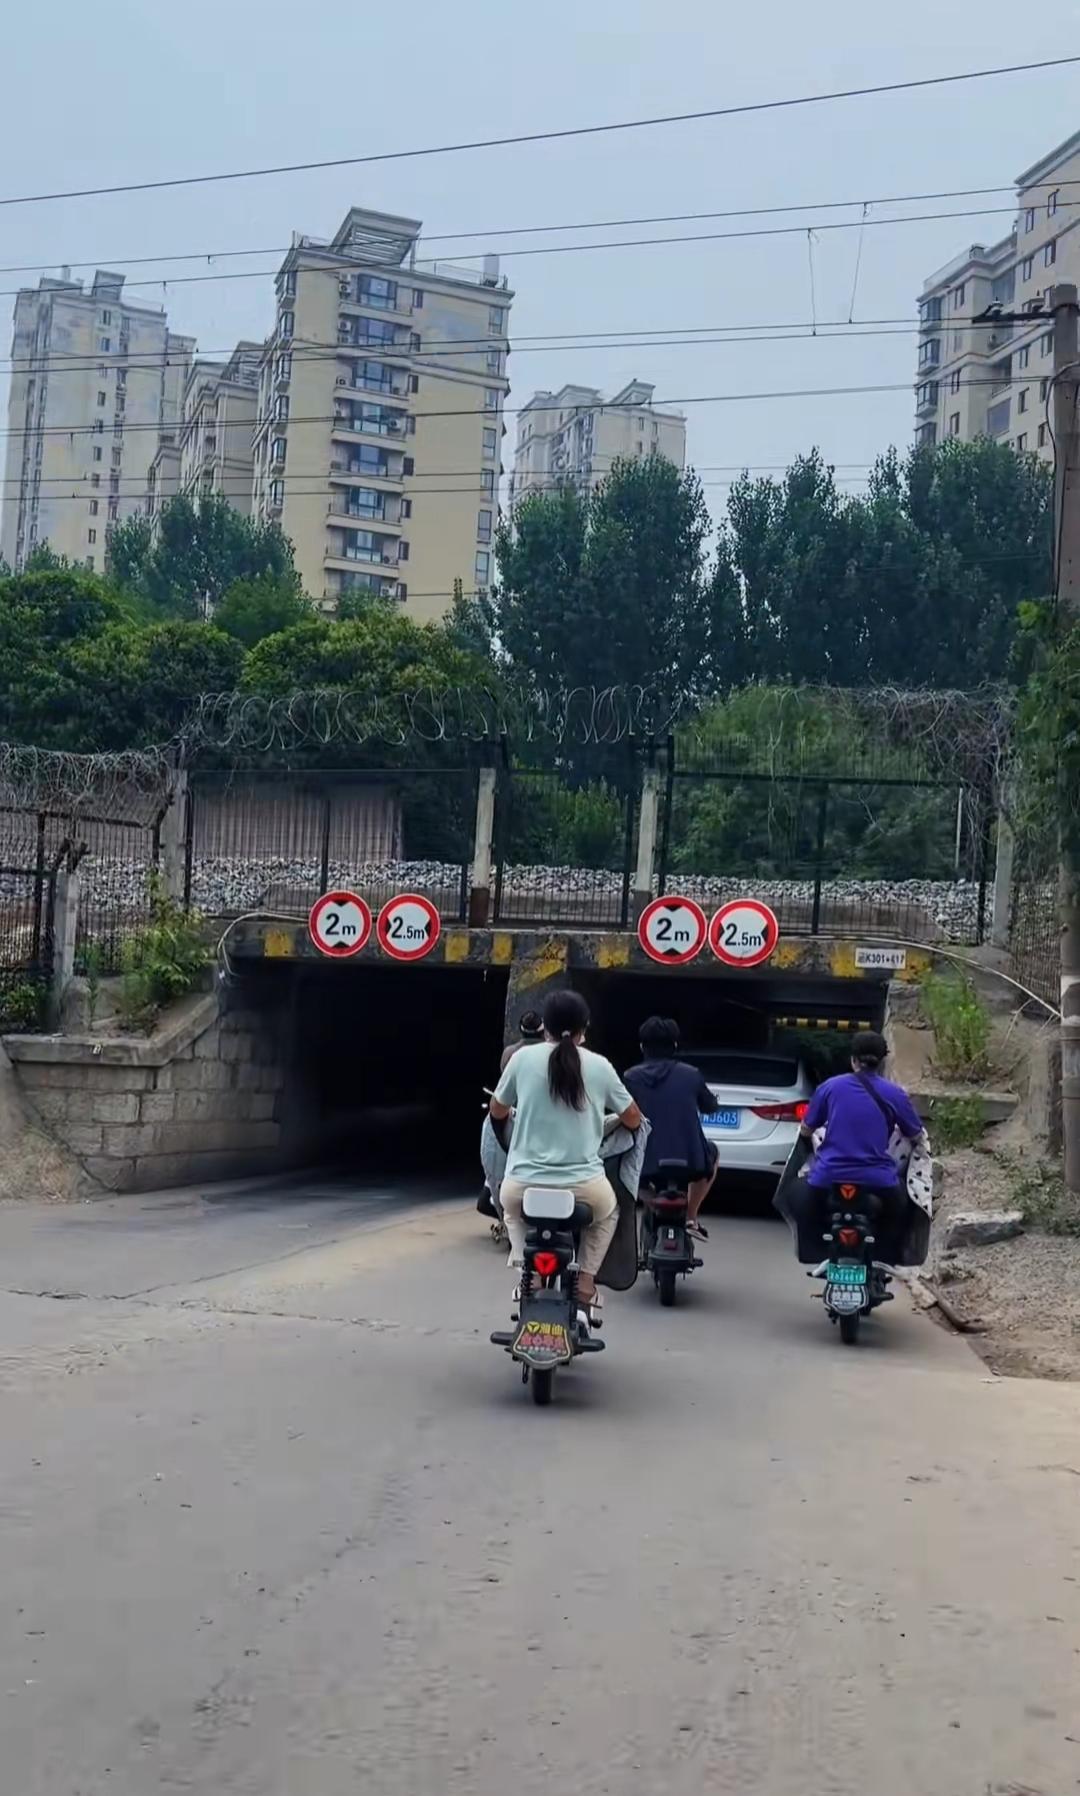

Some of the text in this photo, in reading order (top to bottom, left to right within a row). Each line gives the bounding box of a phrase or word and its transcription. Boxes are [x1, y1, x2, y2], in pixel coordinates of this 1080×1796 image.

[325, 912, 356, 936] 2m
[391, 916, 425, 939] 2.5m
[656, 917, 690, 942] 2m
[724, 922, 762, 946] 2.5m
